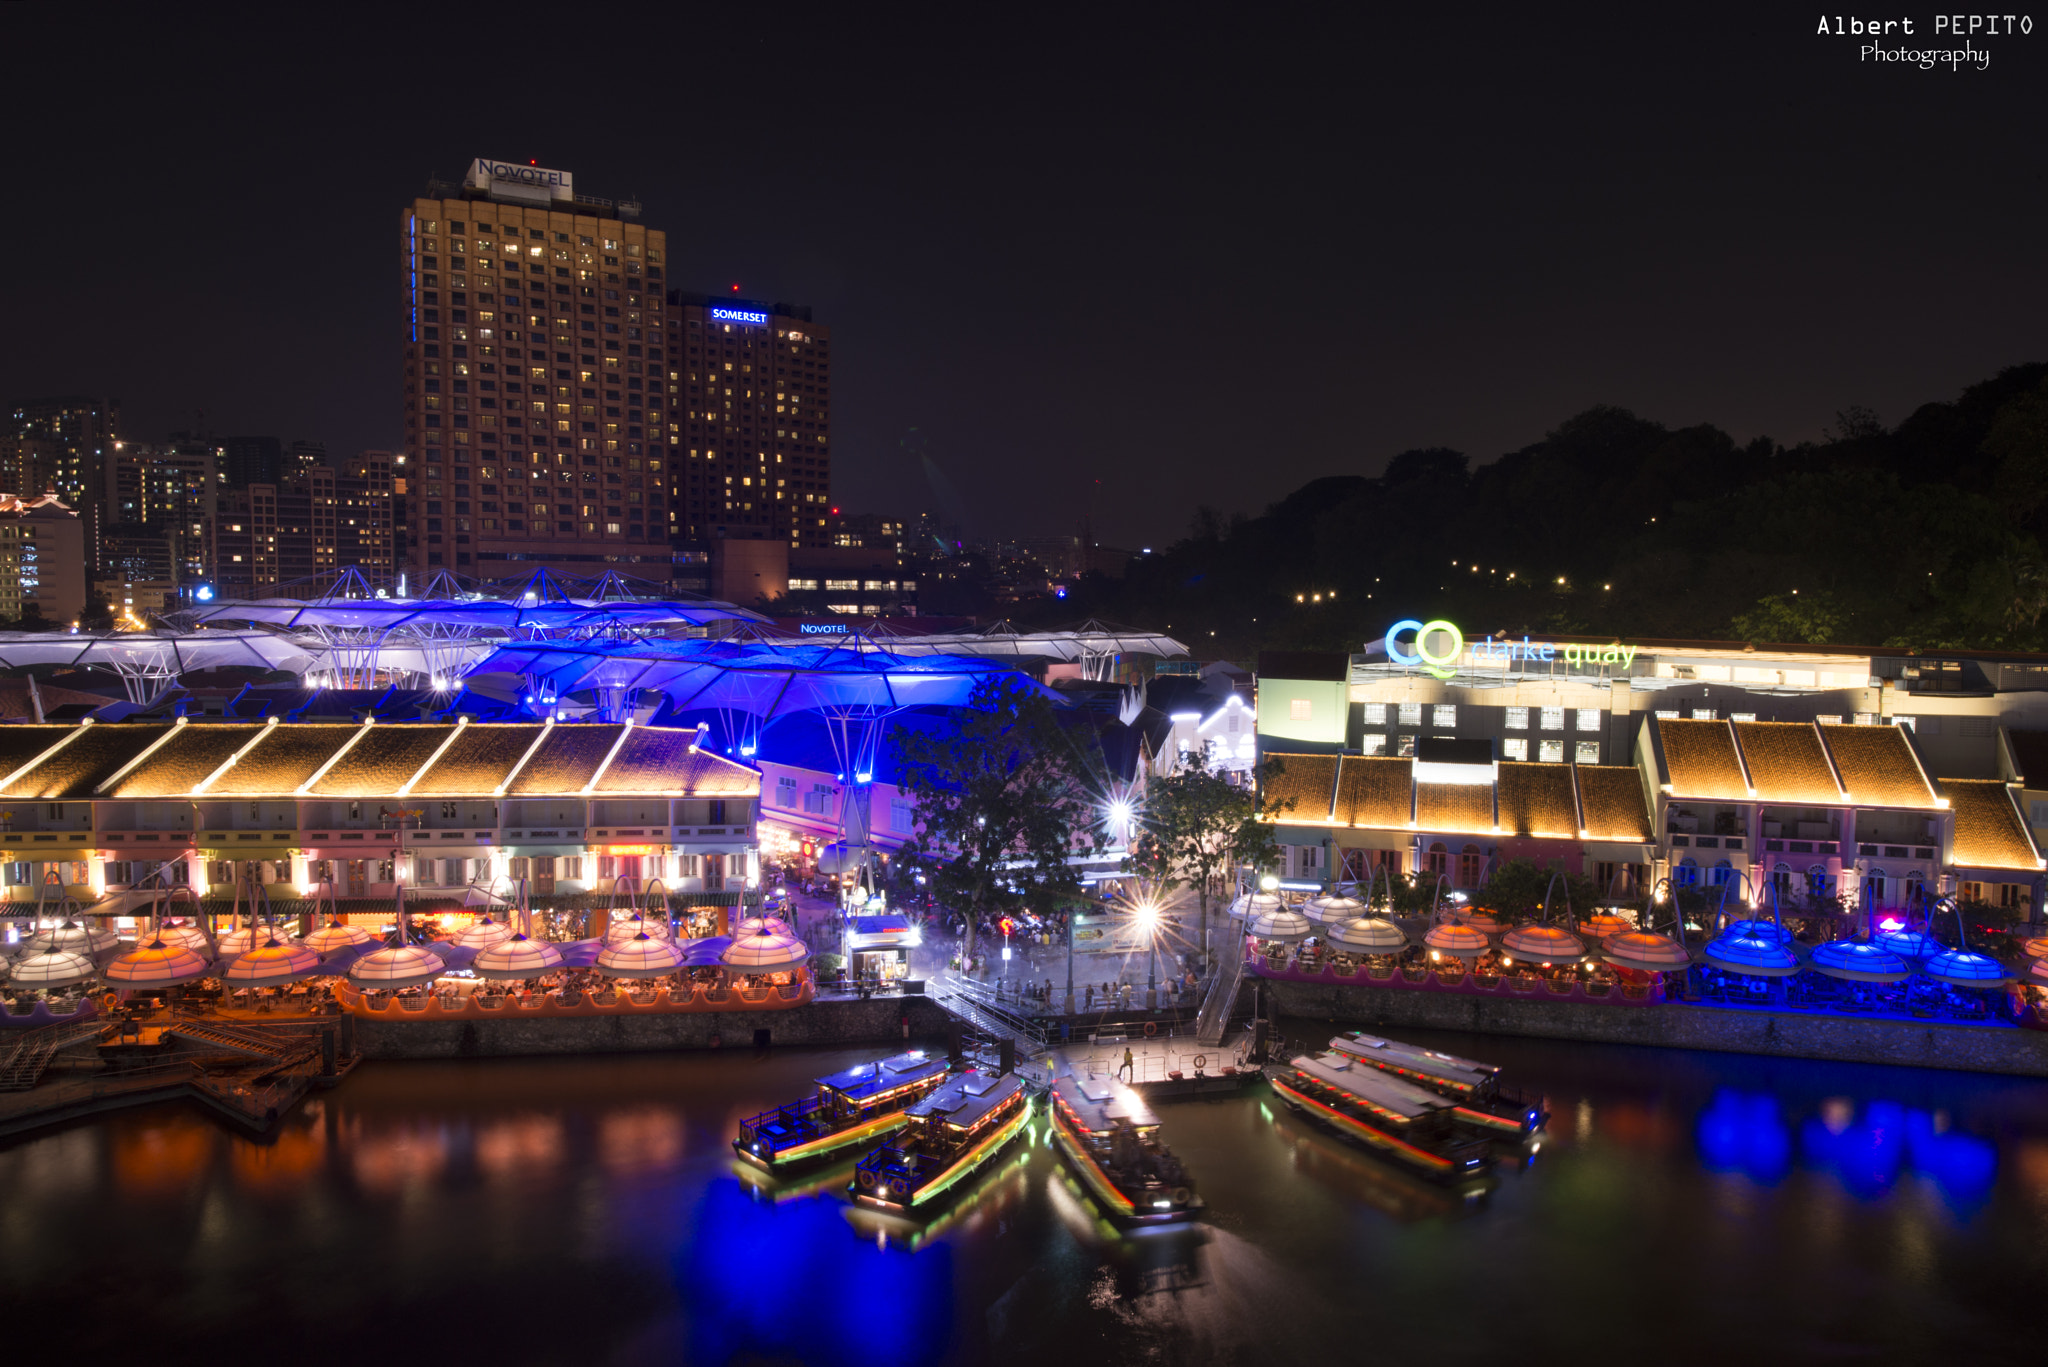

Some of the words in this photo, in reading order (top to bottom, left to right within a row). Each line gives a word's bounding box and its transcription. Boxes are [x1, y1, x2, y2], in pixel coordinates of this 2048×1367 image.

[478, 159, 570, 188] NOVOTEL
[713, 308, 766, 323] SOMERSET
[801, 624, 850, 634] NOVOTEL
[1471, 636, 1556, 662] clarke
[1564, 643, 1637, 670] quay
